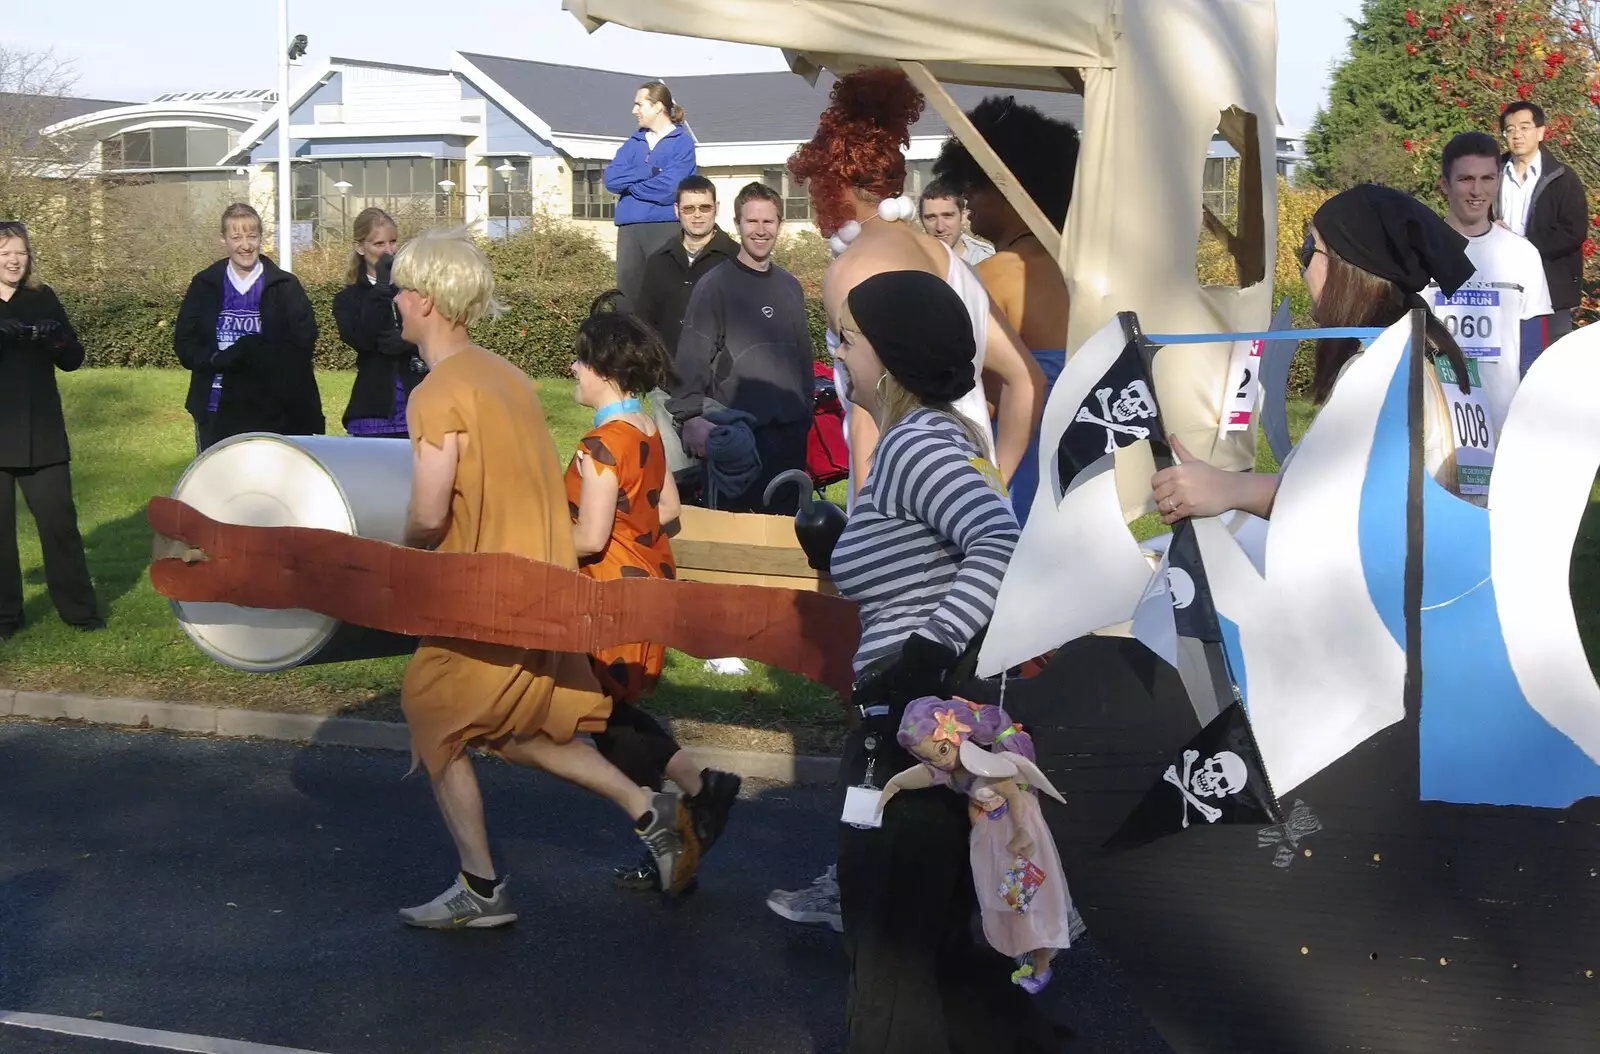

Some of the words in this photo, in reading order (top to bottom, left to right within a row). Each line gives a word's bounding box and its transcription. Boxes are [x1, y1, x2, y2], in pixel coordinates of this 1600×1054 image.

[1445, 297, 1468, 305] FUN
[1470, 297, 1492, 305] RUN
[216, 316, 262, 333] ENOV
[1444, 315, 1493, 339] 060
[1454, 401, 1489, 449] 008
